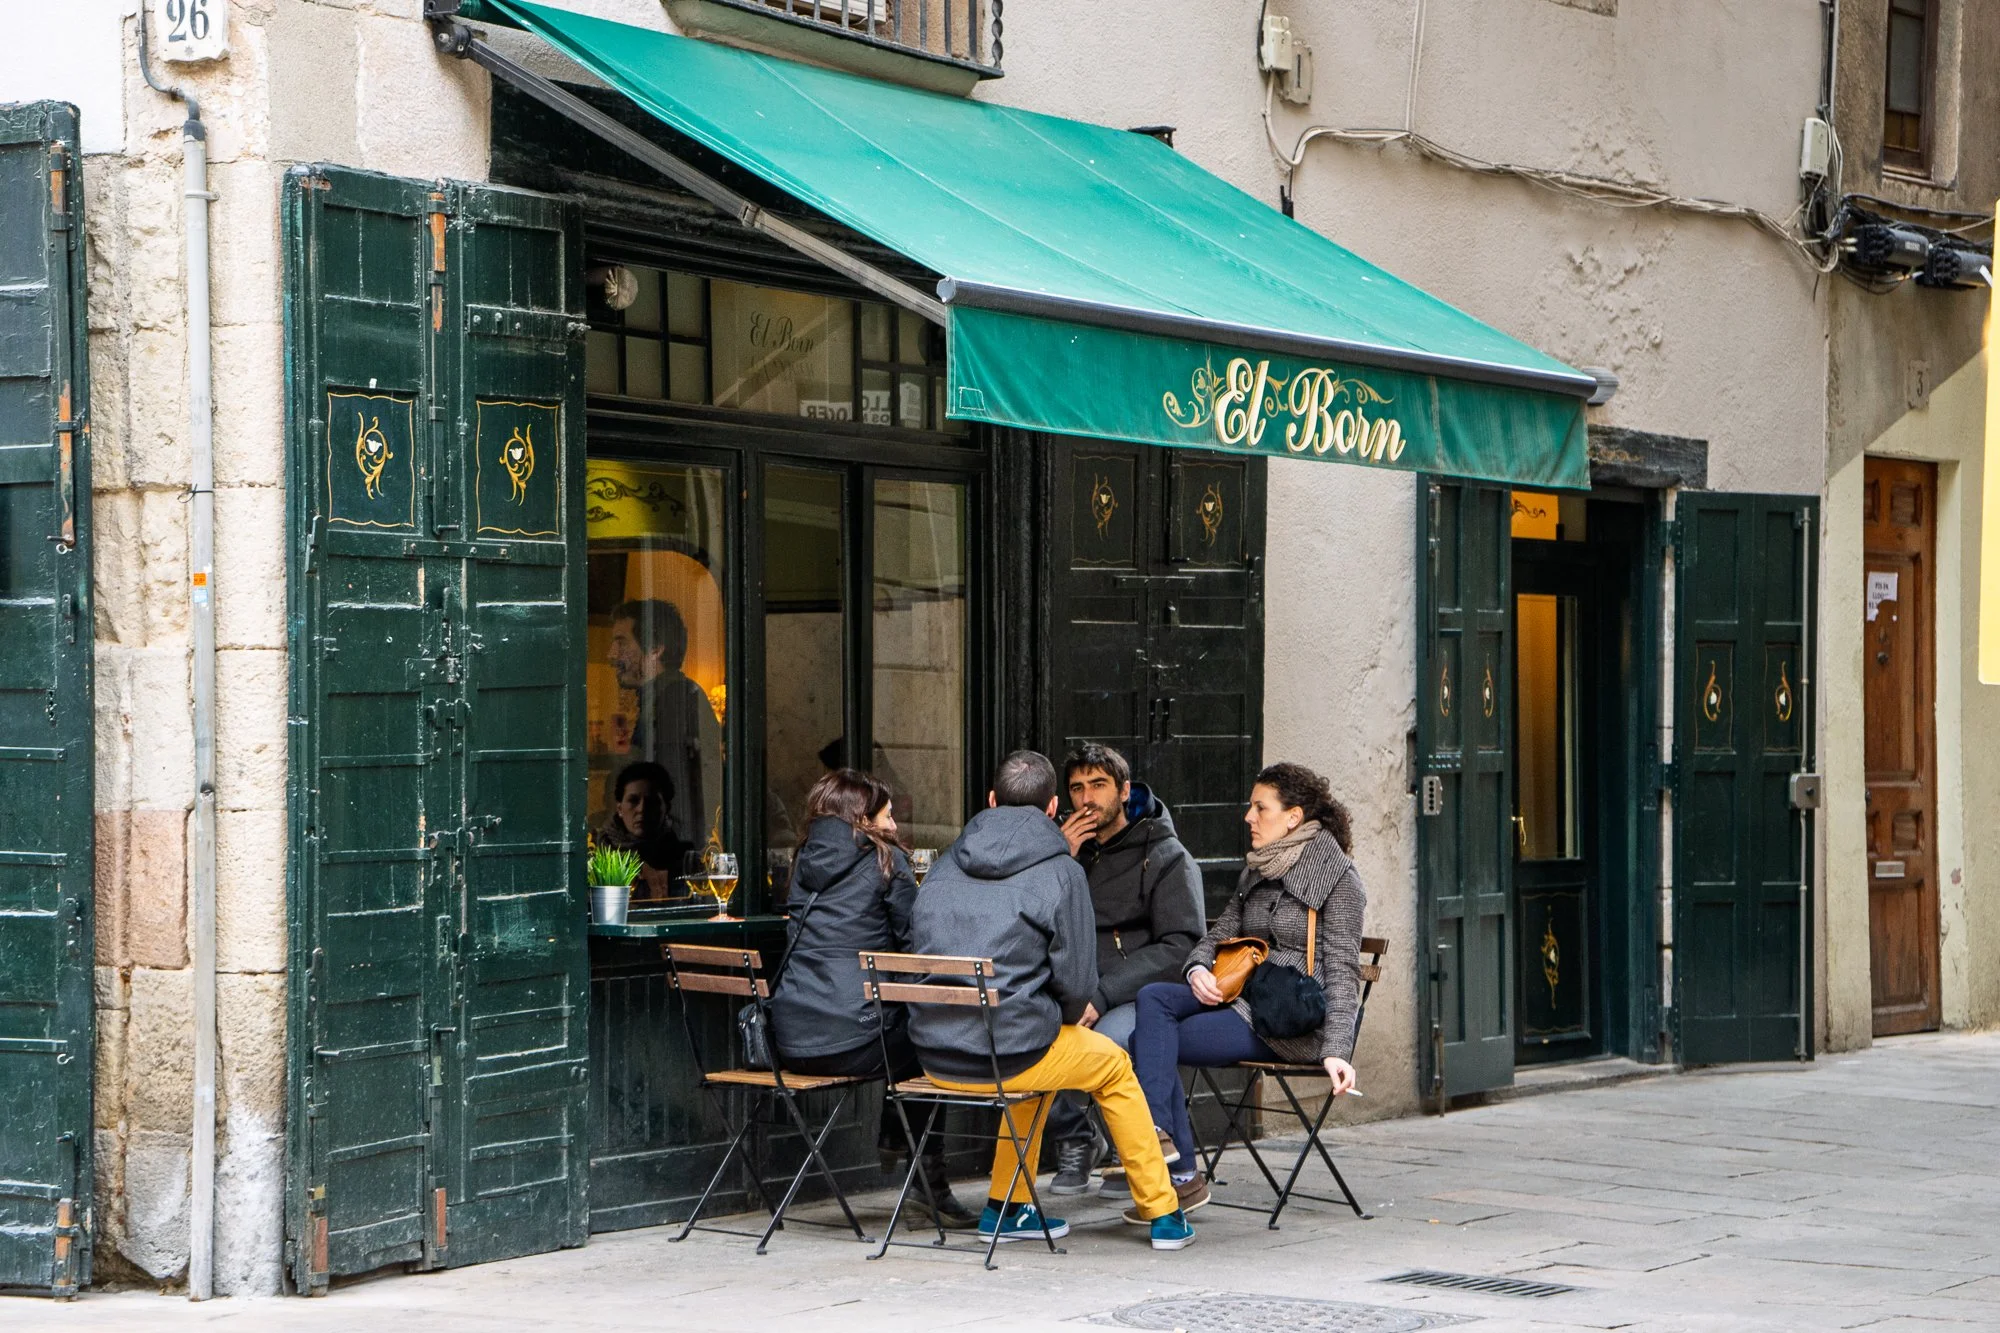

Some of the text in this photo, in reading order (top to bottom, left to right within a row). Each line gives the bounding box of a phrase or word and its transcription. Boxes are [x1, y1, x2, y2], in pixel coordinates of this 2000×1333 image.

[166, 0, 210, 43] 26
[750, 311, 814, 353] El Born
[1916, 370, 1924, 398] 3
[1214, 357, 1406, 464] El Born
